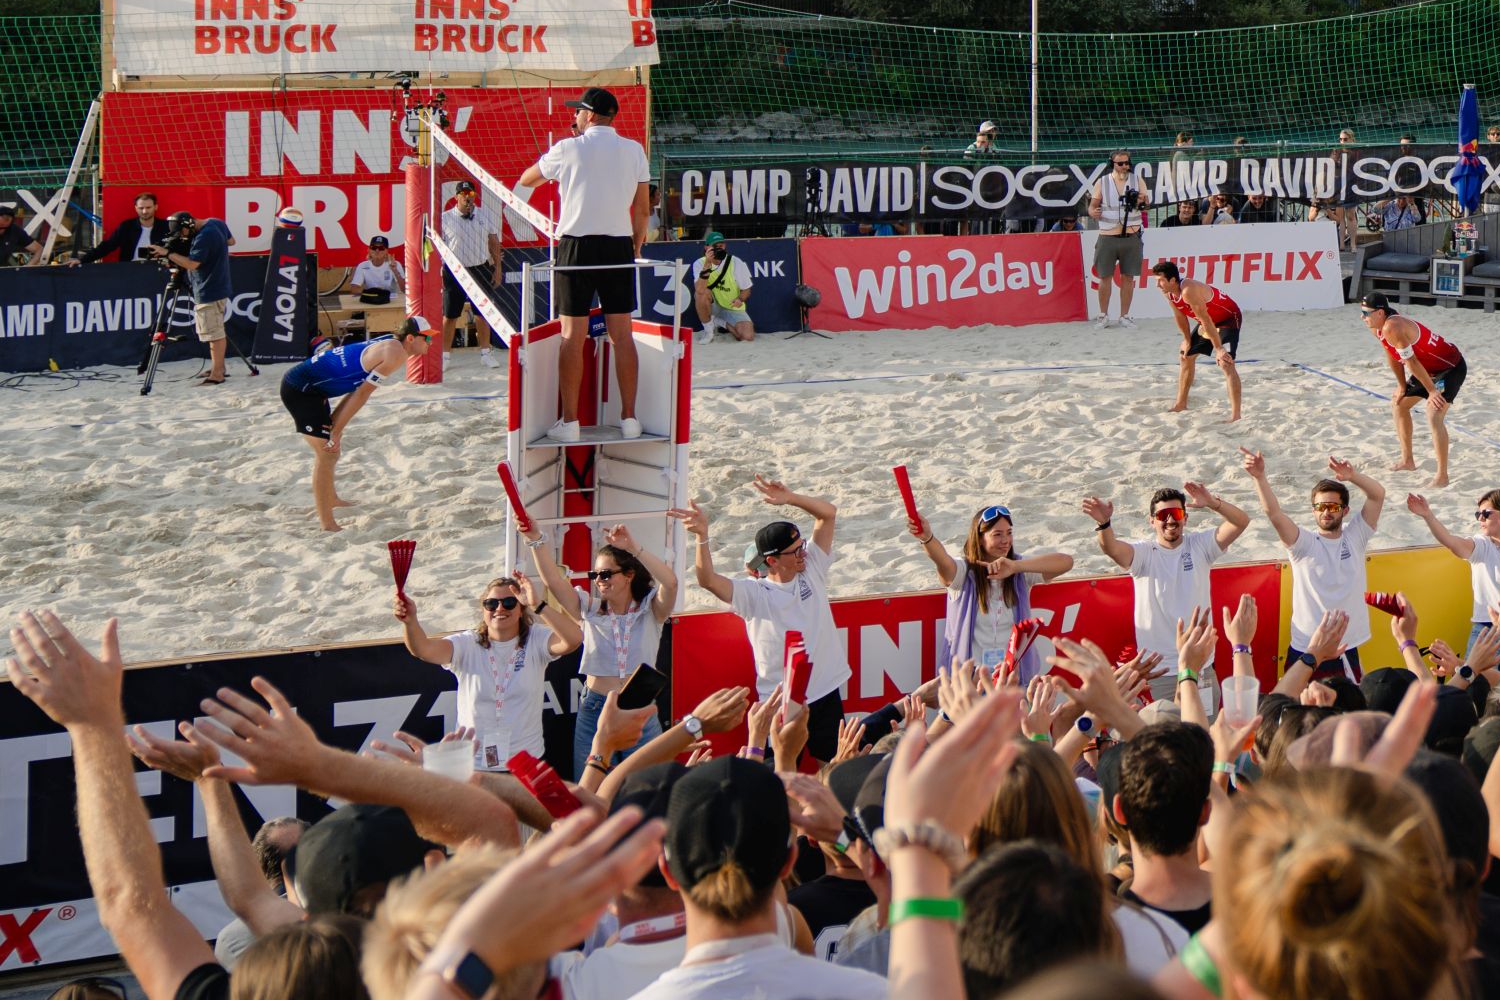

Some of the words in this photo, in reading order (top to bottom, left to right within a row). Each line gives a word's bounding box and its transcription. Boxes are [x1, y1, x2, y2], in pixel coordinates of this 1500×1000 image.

[195, 24, 337, 55] BRUCK
[414, 24, 547, 53] BRUCK
[682, 168, 792, 216] CAMP
[1240, 157, 1336, 200] DAVID
[834, 248, 1053, 319] win2day
[66, 297, 151, 334] DAVID
